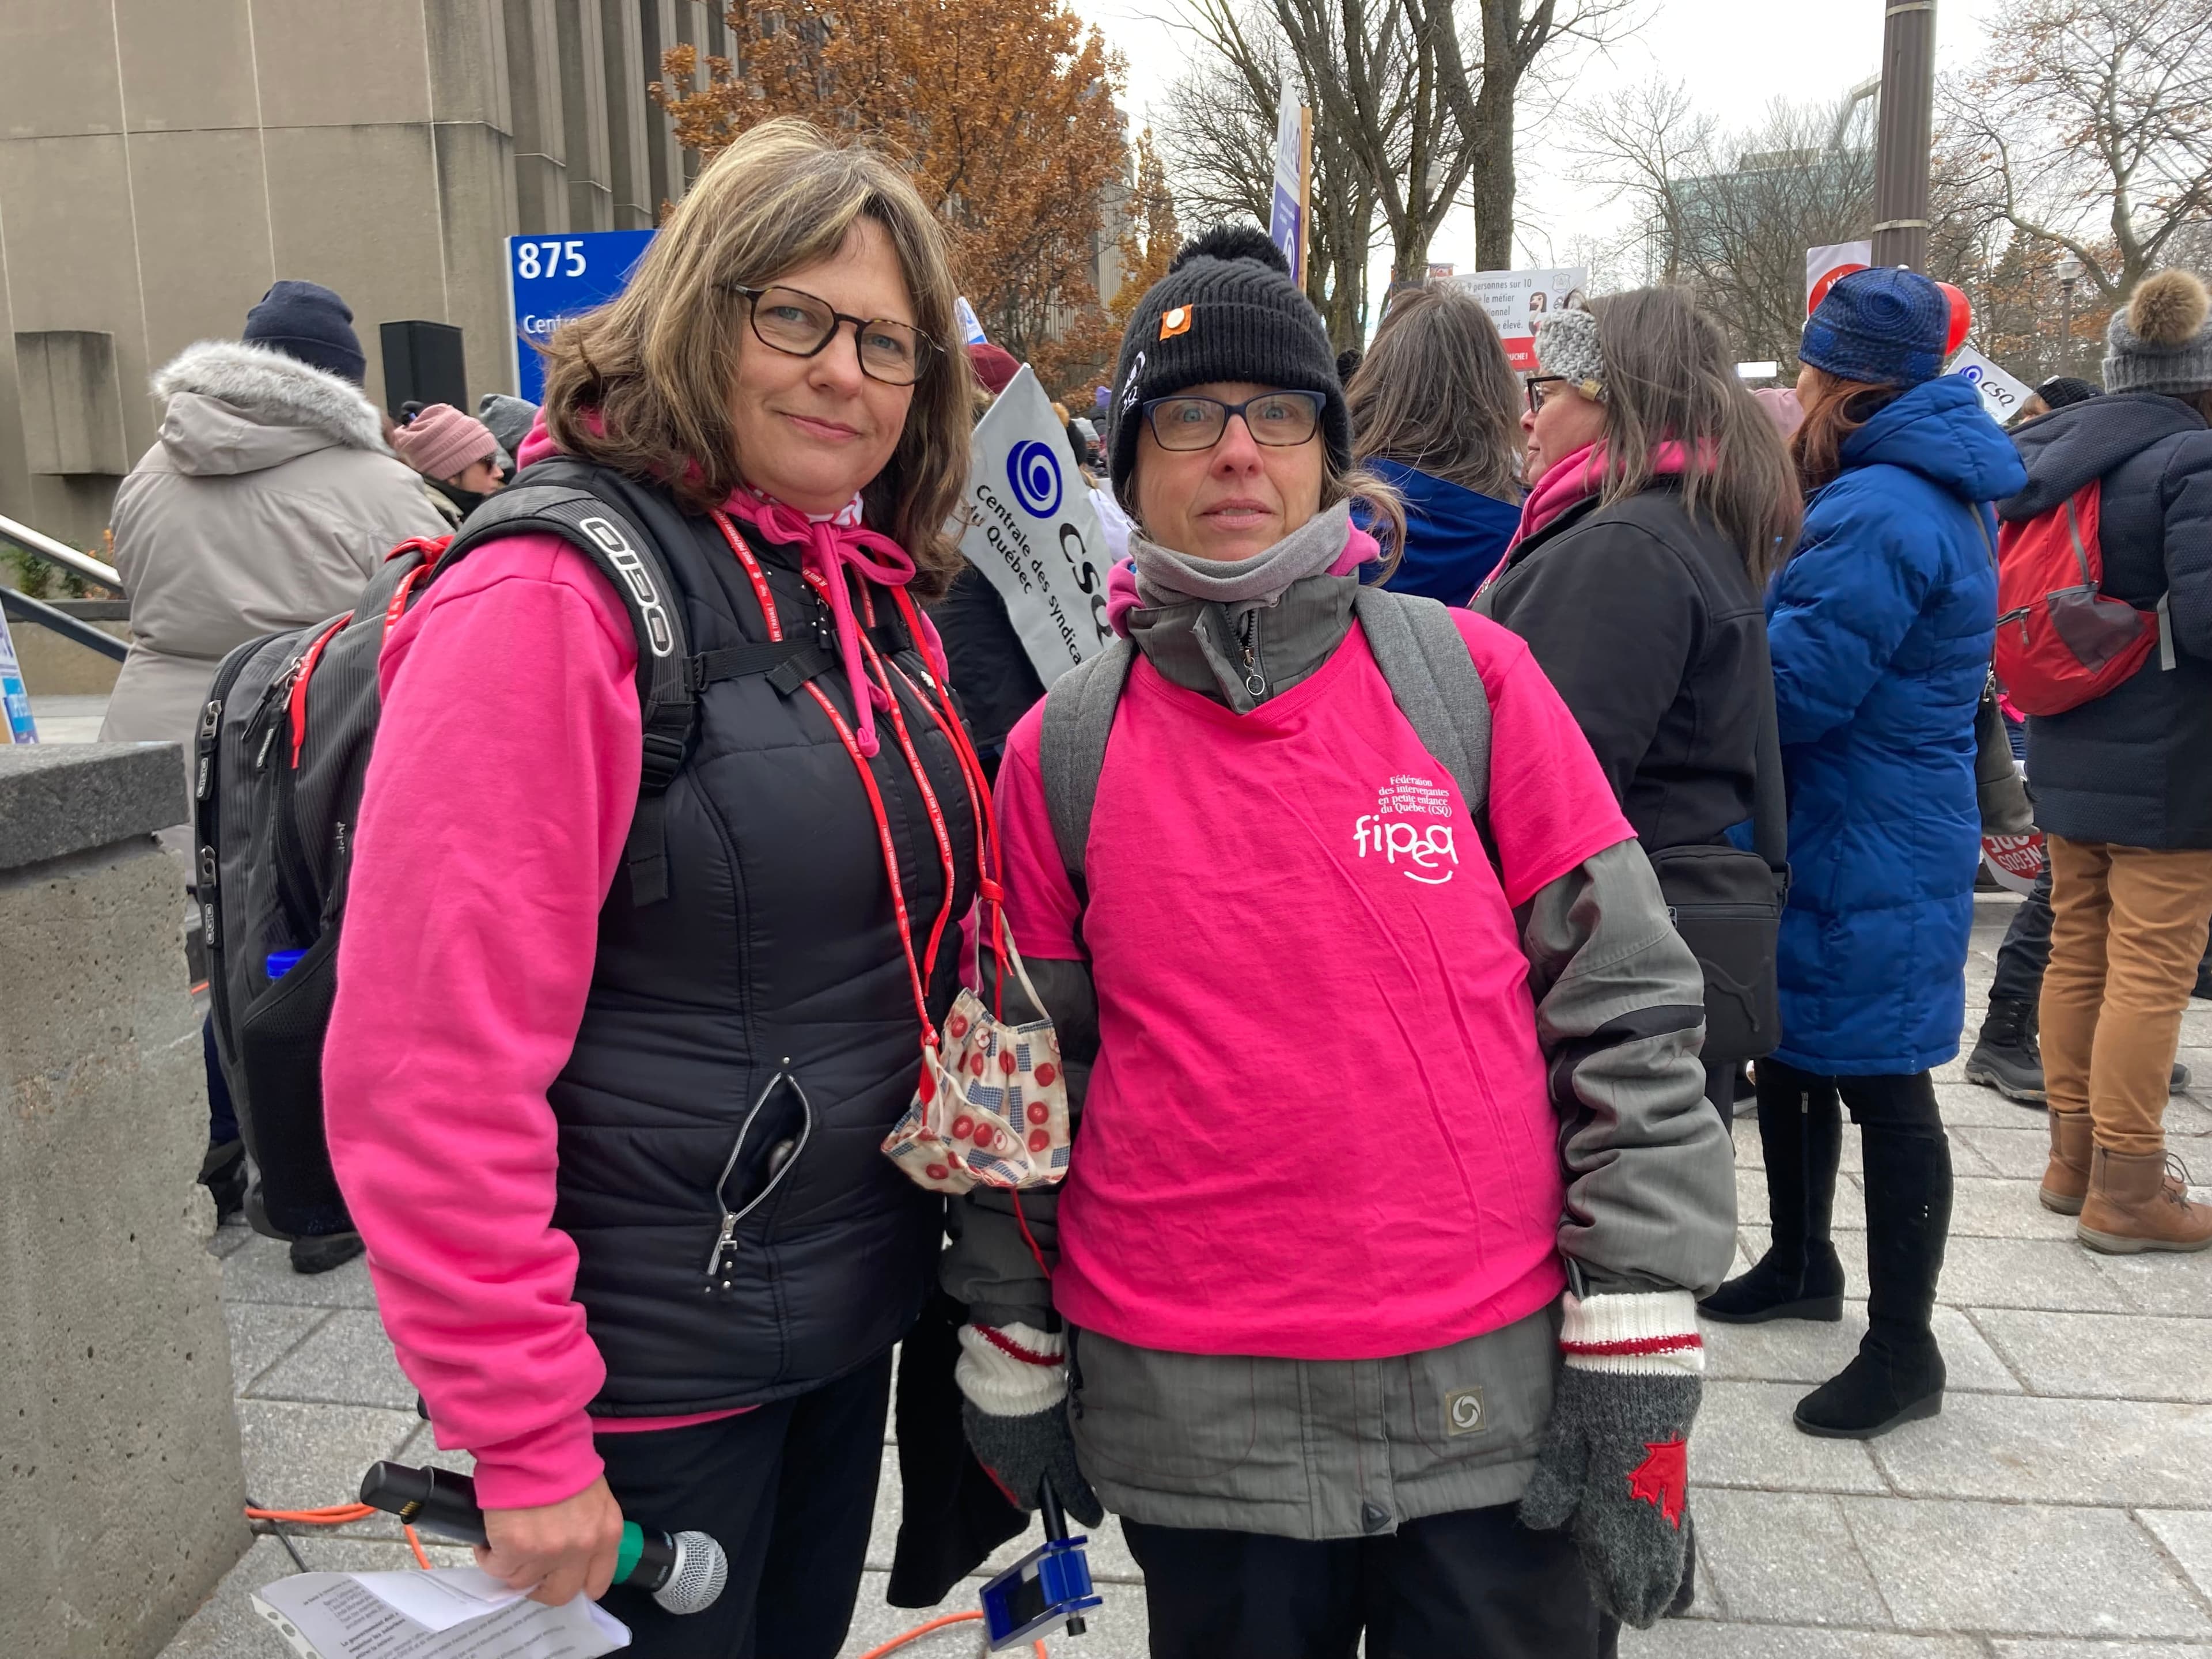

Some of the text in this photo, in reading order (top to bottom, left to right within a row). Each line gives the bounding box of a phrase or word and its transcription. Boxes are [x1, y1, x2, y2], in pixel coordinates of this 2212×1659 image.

[518, 240, 587, 279] 875
[1474, 282, 1508, 293] personnes
[1524, 278, 1532, 288] 10
[1484, 294, 1490, 303] le
[1492, 293, 1515, 303] métier
[1981, 381, 2015, 408] CSQ
[976, 484, 1031, 558] Centrale
[1032, 559, 1051, 593] des
[987, 525, 1033, 594] Québec
[1059, 522, 1114, 648] CSQ
[1378, 784, 1450, 797] des intervenantes
[1389, 774, 1433, 787] Fédération
[1378, 794, 1448, 806] en petite enfance
[1380, 802, 1452, 818] du Québec (CSQ)
[1353, 814, 1459, 868] fipeq
